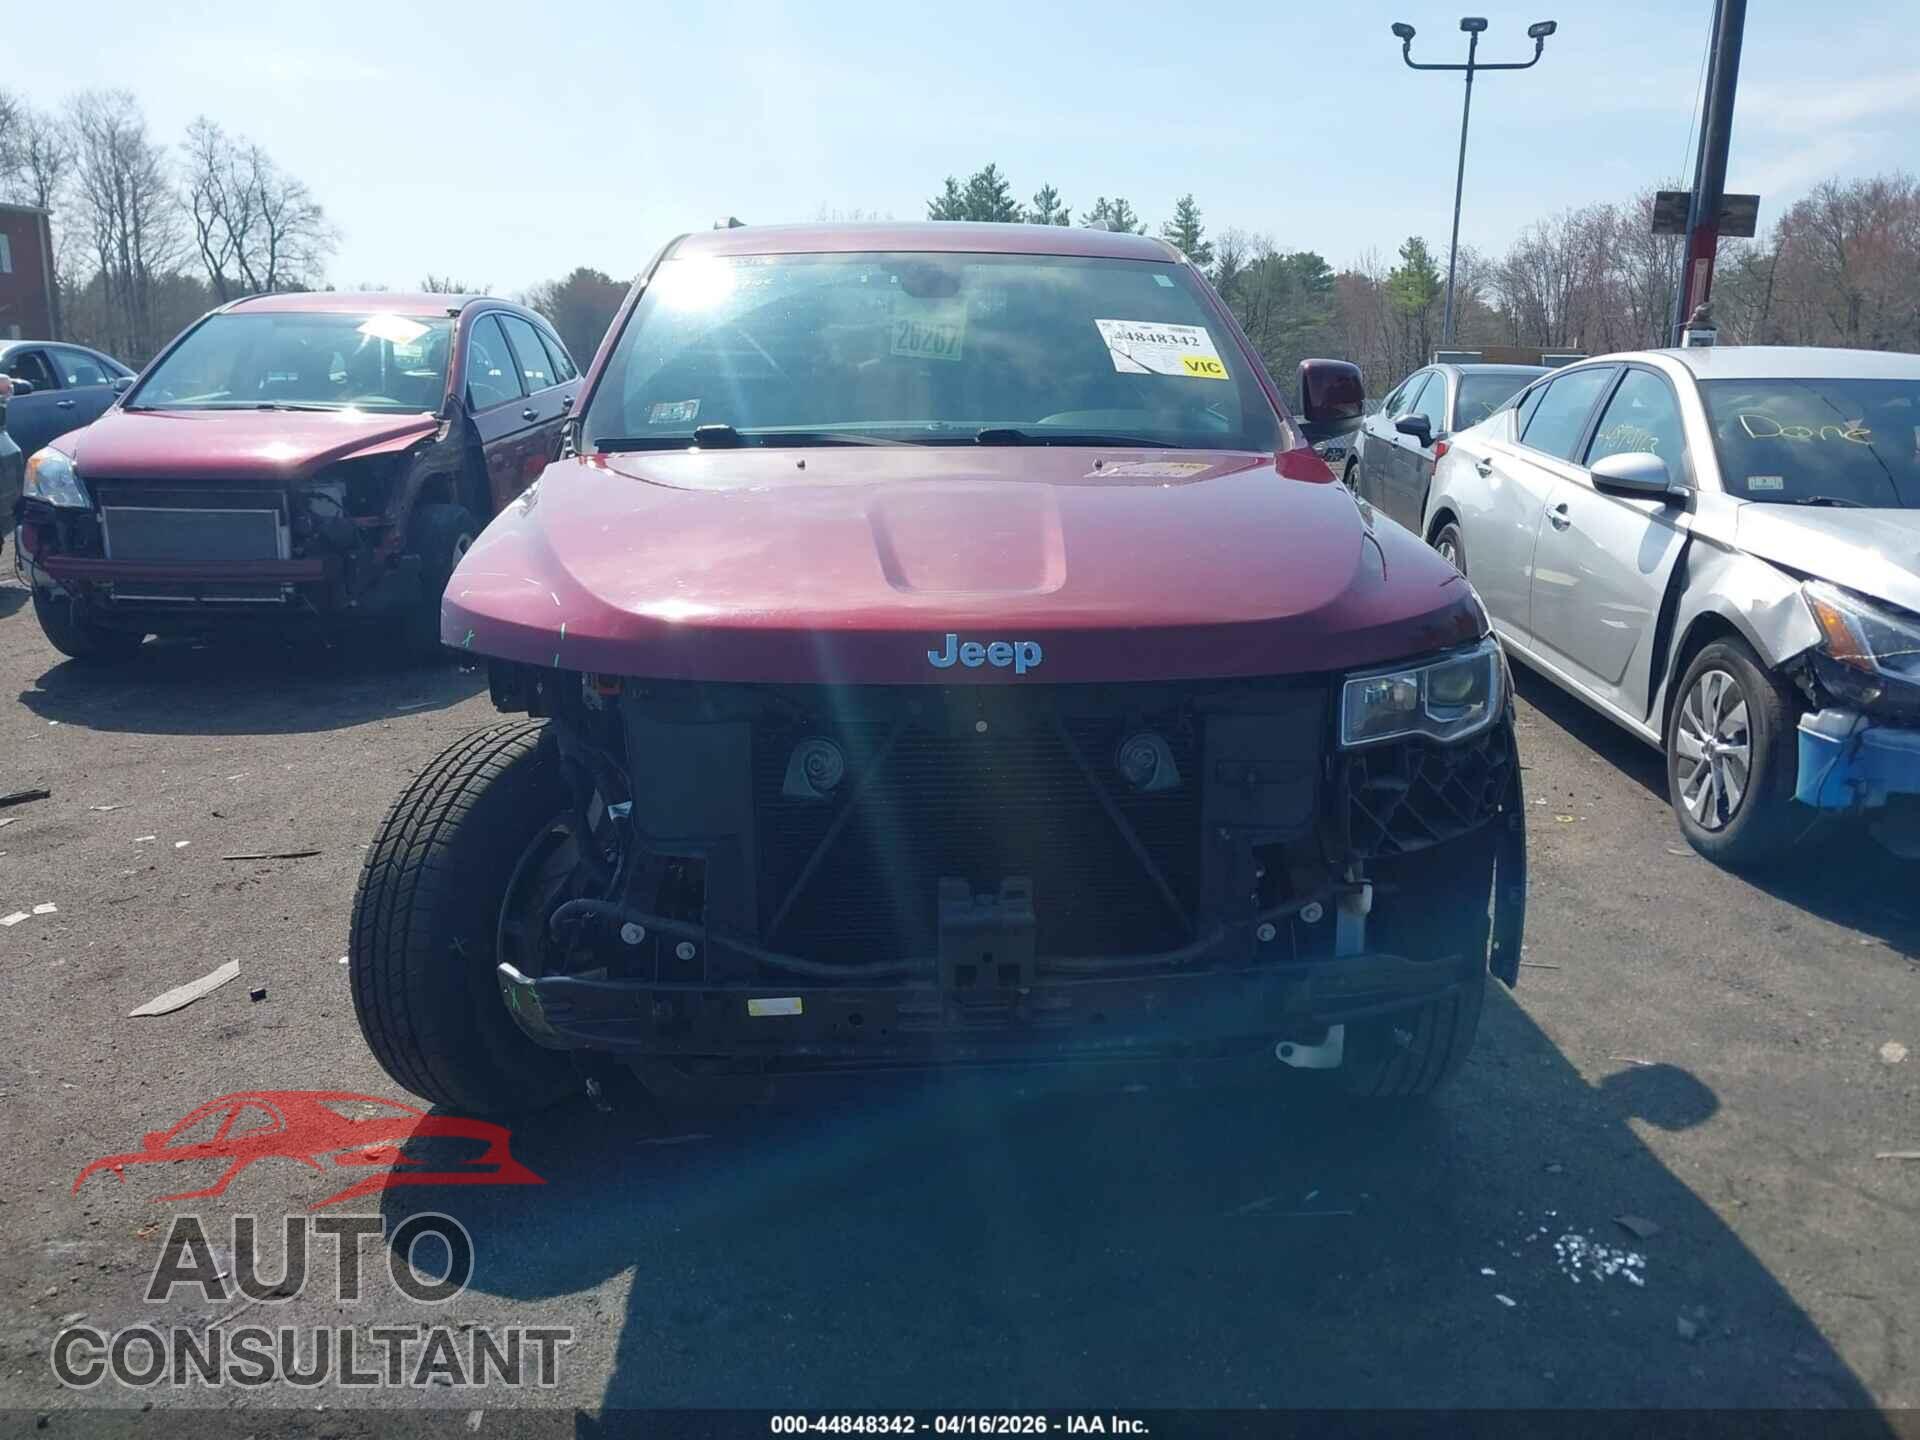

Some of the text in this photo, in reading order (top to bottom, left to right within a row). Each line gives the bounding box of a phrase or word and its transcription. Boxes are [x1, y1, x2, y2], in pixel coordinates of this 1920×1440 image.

[1113, 330, 1201, 347] 44848342
[1184, 360, 1222, 374] VIC
[1737, 413, 1875, 445] Done
[927, 633, 1042, 674] Jeep
